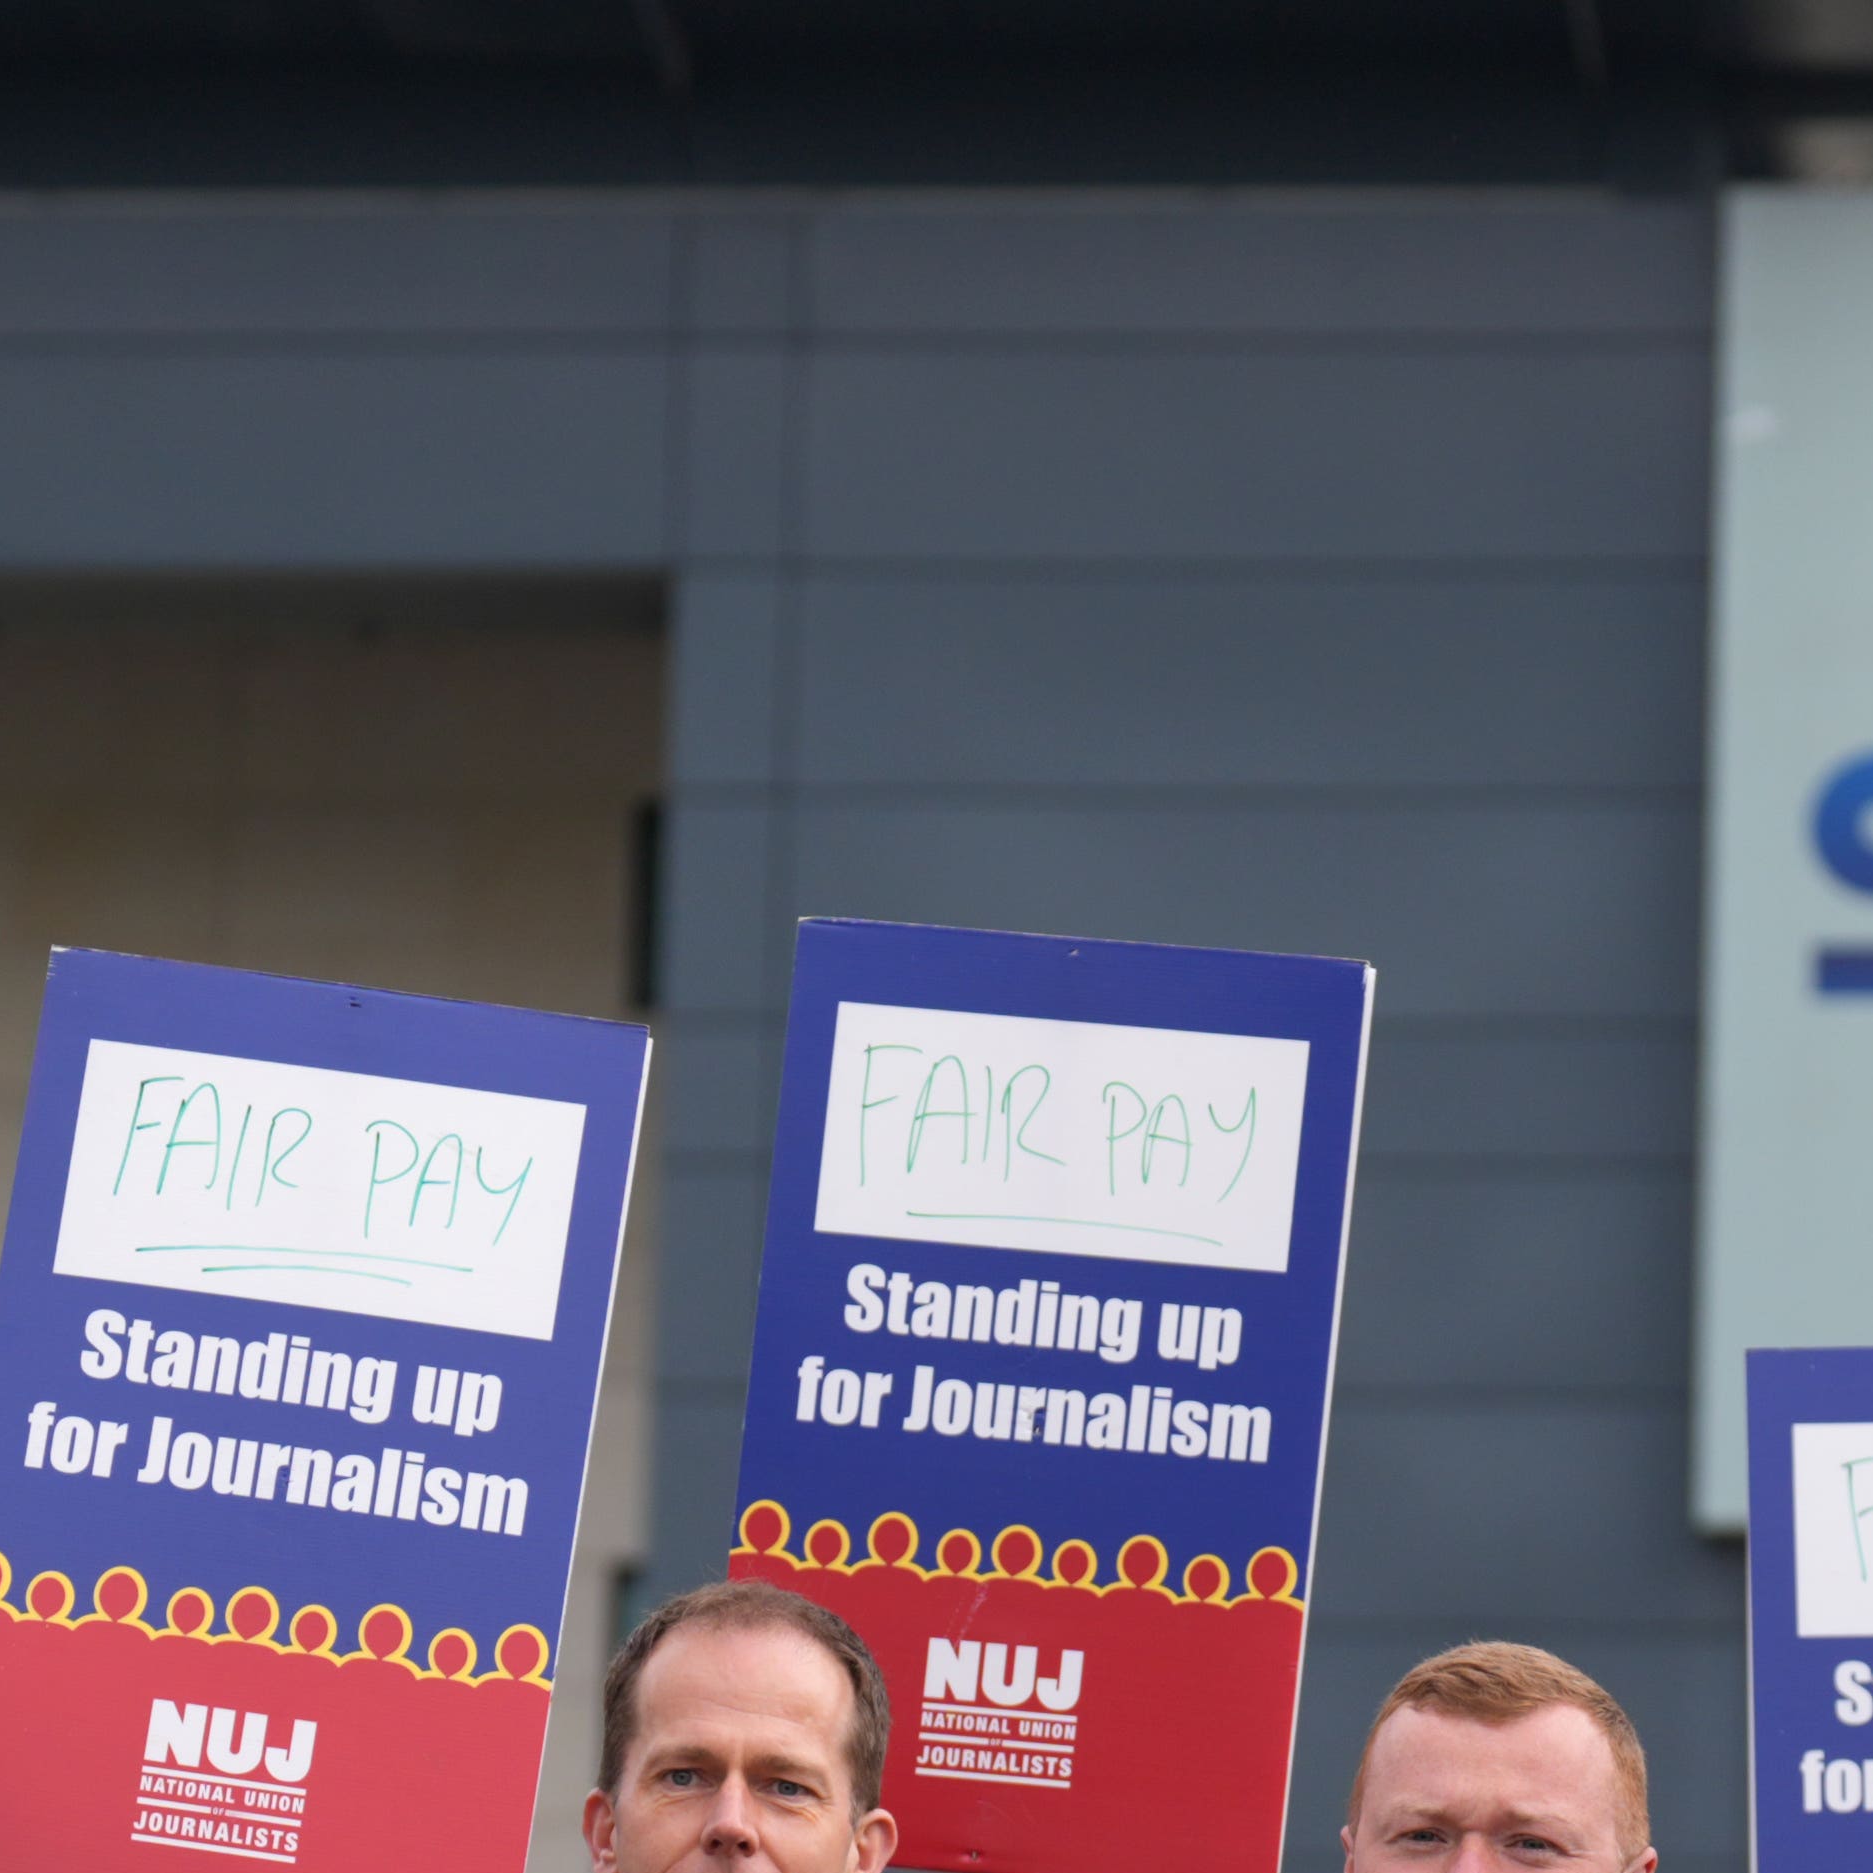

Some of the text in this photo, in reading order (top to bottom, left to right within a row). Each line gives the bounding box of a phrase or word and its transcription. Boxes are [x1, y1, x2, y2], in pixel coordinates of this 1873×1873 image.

[112, 1075, 533, 1247] FAIR PAY
[860, 1042, 1257, 1204] FAIR PAY
[843, 1262, 1244, 1371] Standing up
[80, 1309, 503, 1438] Standing up
[796, 1355, 1273, 1464] for Journalism
[24, 1401, 529, 1537] for Journalism
[923, 1636, 1085, 1712] NUJ
[143, 1697, 318, 1783] NUJ
[916, 1745, 1073, 1778] JOURNALISTS
[920, 1710, 1077, 1741] NATIONAL UNION
[133, 1810, 299, 1853] JOURNALISTS
[139, 1774, 306, 1815] NATIONAL UNION
